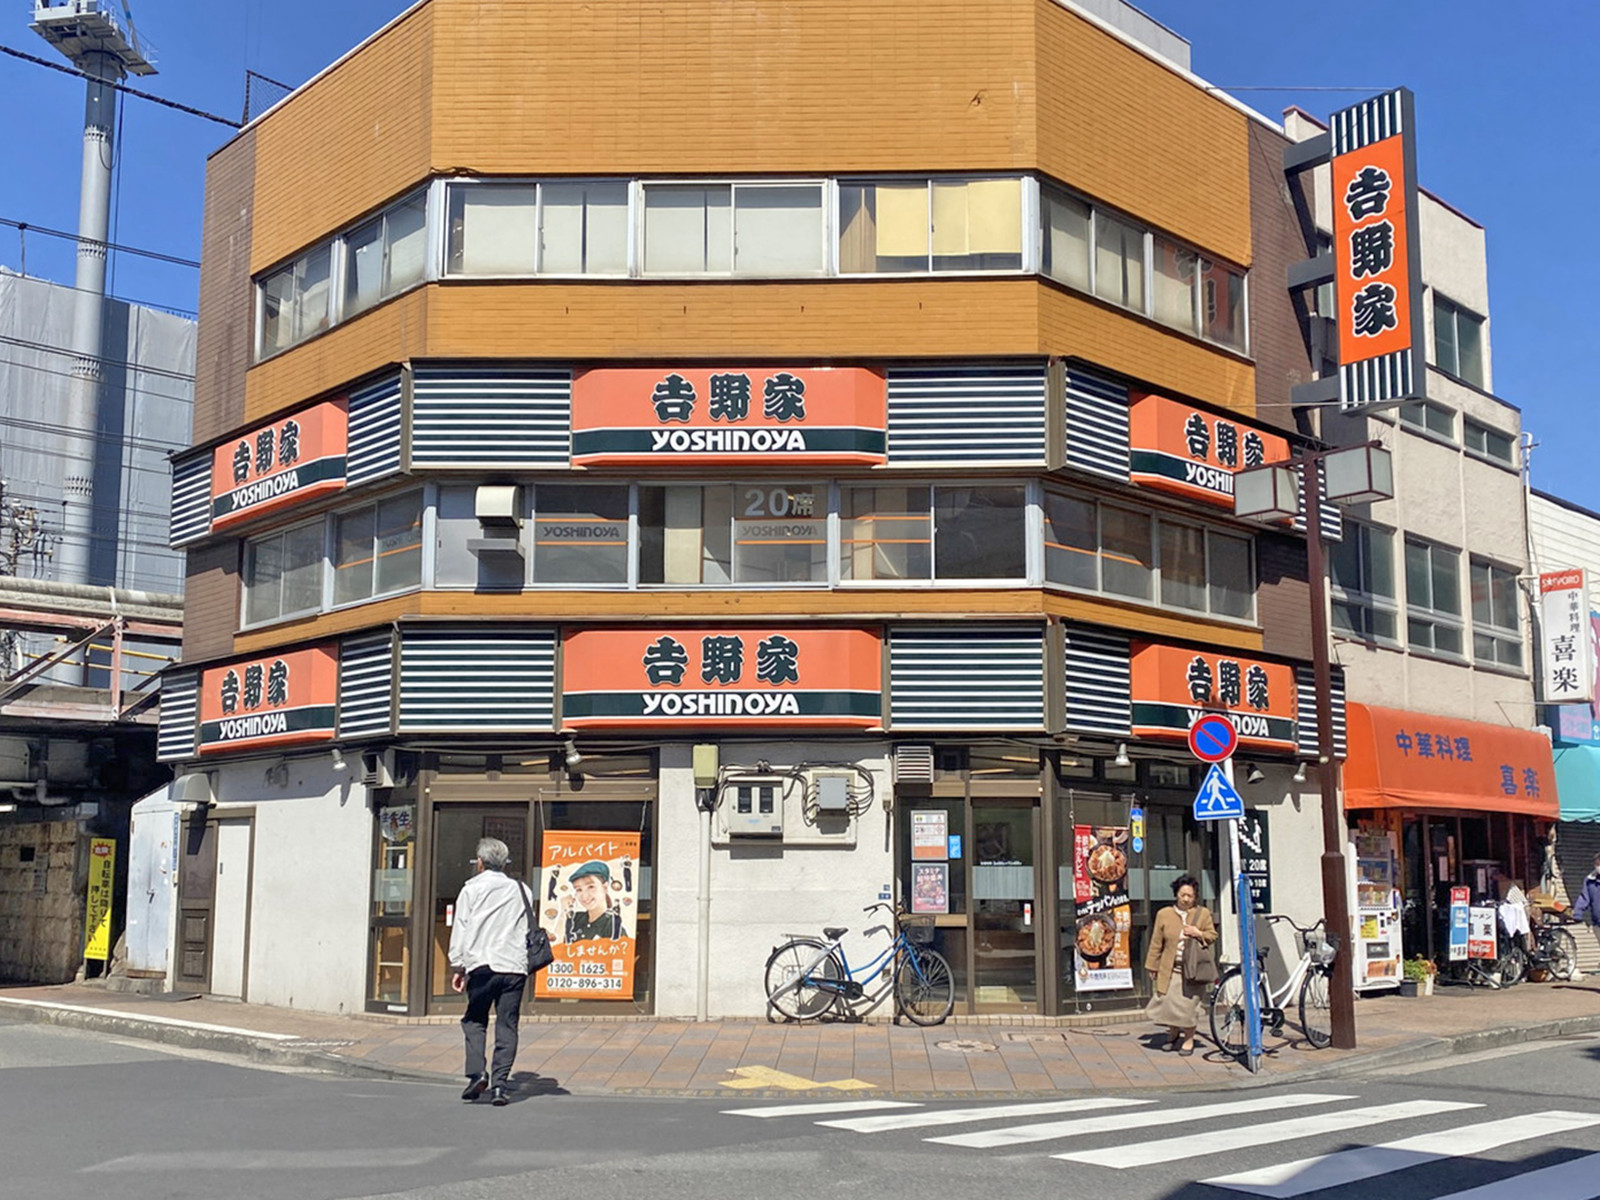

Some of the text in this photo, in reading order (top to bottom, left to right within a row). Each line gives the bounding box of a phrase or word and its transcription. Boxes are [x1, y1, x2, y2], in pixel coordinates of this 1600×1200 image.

[651, 430, 806, 451] YOSHINOYA
[231, 471, 298, 509] YOSHINOYA
[544, 526, 620, 538] YOSHINOYA
[743, 525, 818, 537] YOSHINOYA
[1568, 590, 1580, 633] 中華料理
[1551, 635, 1579, 693] 喜楽
[642, 693, 800, 715] YOSHINOYA
[220, 713, 287, 739] YOSHINOYA
[1396, 729, 1473, 762] 中華料理
[548, 841, 618, 860] アルバイト
[1471, 912, 1492, 920] ーメン
[567, 941, 629, 958] しませんか？
[550, 963, 573, 974] 1300
[581, 963, 605, 974] 1625
[547, 977, 622, 988] 0120-896-314
